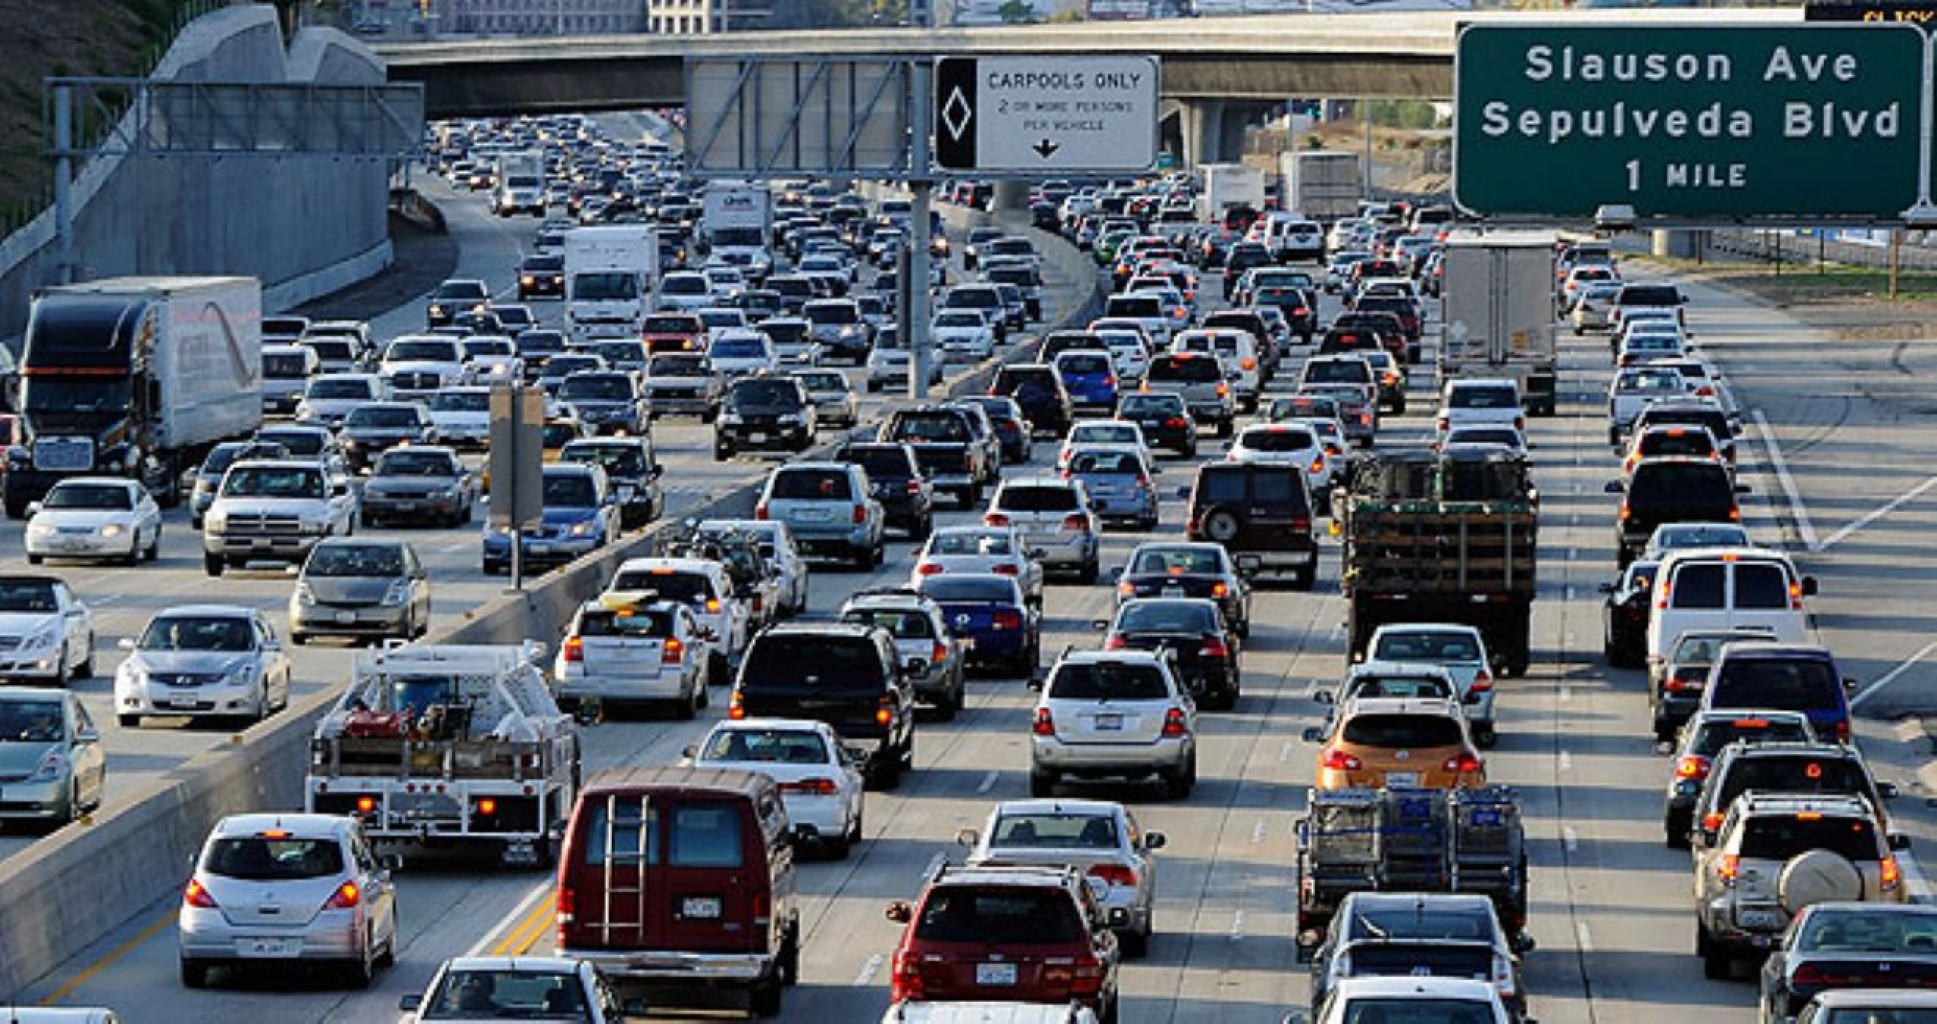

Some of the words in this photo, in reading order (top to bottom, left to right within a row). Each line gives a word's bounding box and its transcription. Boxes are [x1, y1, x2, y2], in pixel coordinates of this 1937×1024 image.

[1525, 45, 1731, 80] Slauson
[1763, 46, 1857, 80] Ave
[988, 72, 1084, 89] CARPOOLS
[1095, 72, 1142, 89] ONLY
[998, 100, 1009, 115] 2
[1014, 102, 1032, 113] OR
[1036, 102, 1069, 113] MORE
[1076, 102, 1133, 113] PERSONS
[1481, 102, 1752, 144] Sepulveda
[1784, 102, 1900, 137] Blvd
[1626, 160, 1640, 191] 1
[1667, 164, 1747, 188] MILE
